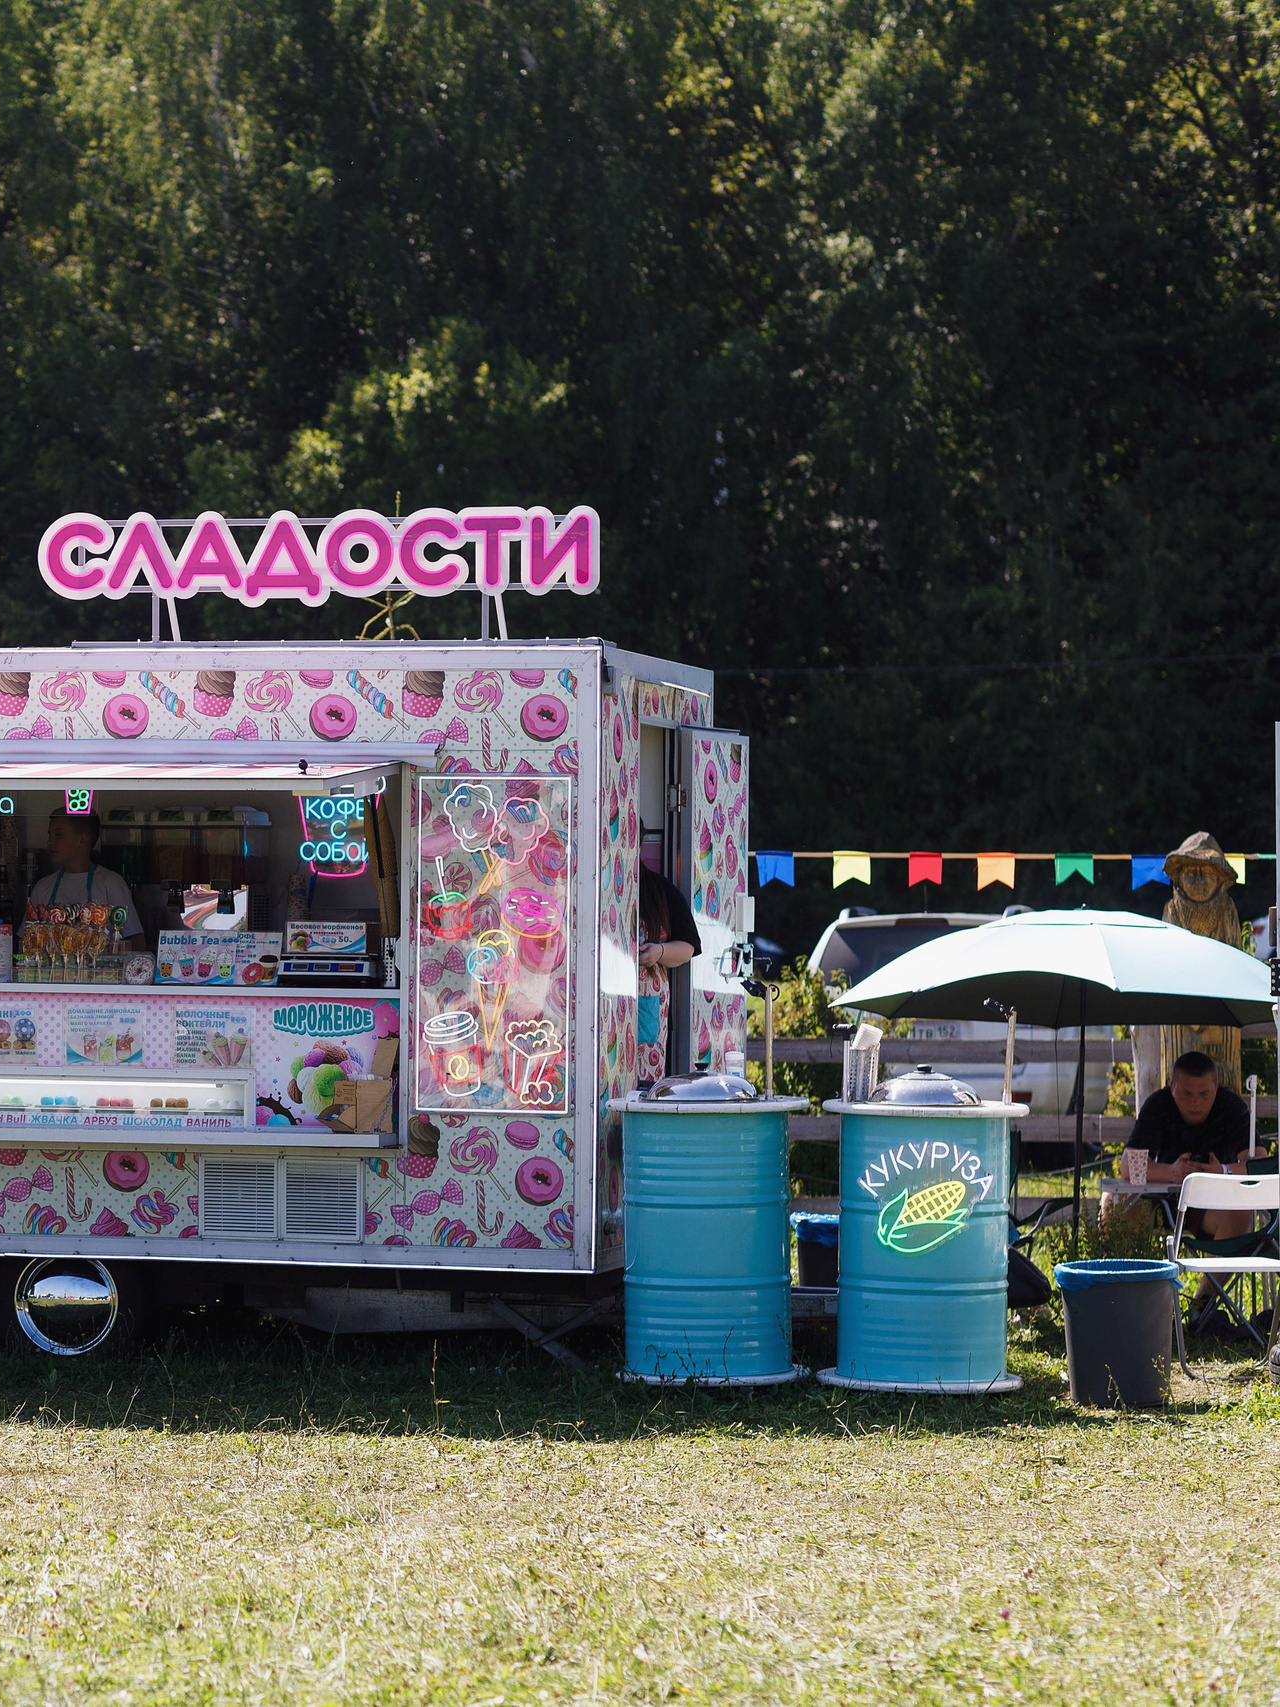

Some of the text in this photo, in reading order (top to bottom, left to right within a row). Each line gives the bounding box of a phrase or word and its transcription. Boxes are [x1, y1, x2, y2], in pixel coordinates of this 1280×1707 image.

[45, 512, 594, 598] СЛАДОСТИ
[305, 798, 365, 820] КОФЕ
[330, 819, 347, 840] С
[160, 934, 198, 945] Bubble
[200, 935, 220, 945] Tea
[175, 1010, 230, 1019] МОЛОЧНЫЕ
[273, 1003, 373, 1033] МОРОЖЕНОЕ
[937, 1025, 956, 1038] 152
[5, 1114, 26, 1124] Bull
[31, 1115, 78, 1125] ЖВАЧКА
[83, 1116, 118, 1126] АРБУЗ
[122, 1117, 182, 1128] ШОКОЛАД
[186, 1118, 231, 1128] ВАНИЛЬ
[858, 1141, 994, 1201] КУКУРУЗА
